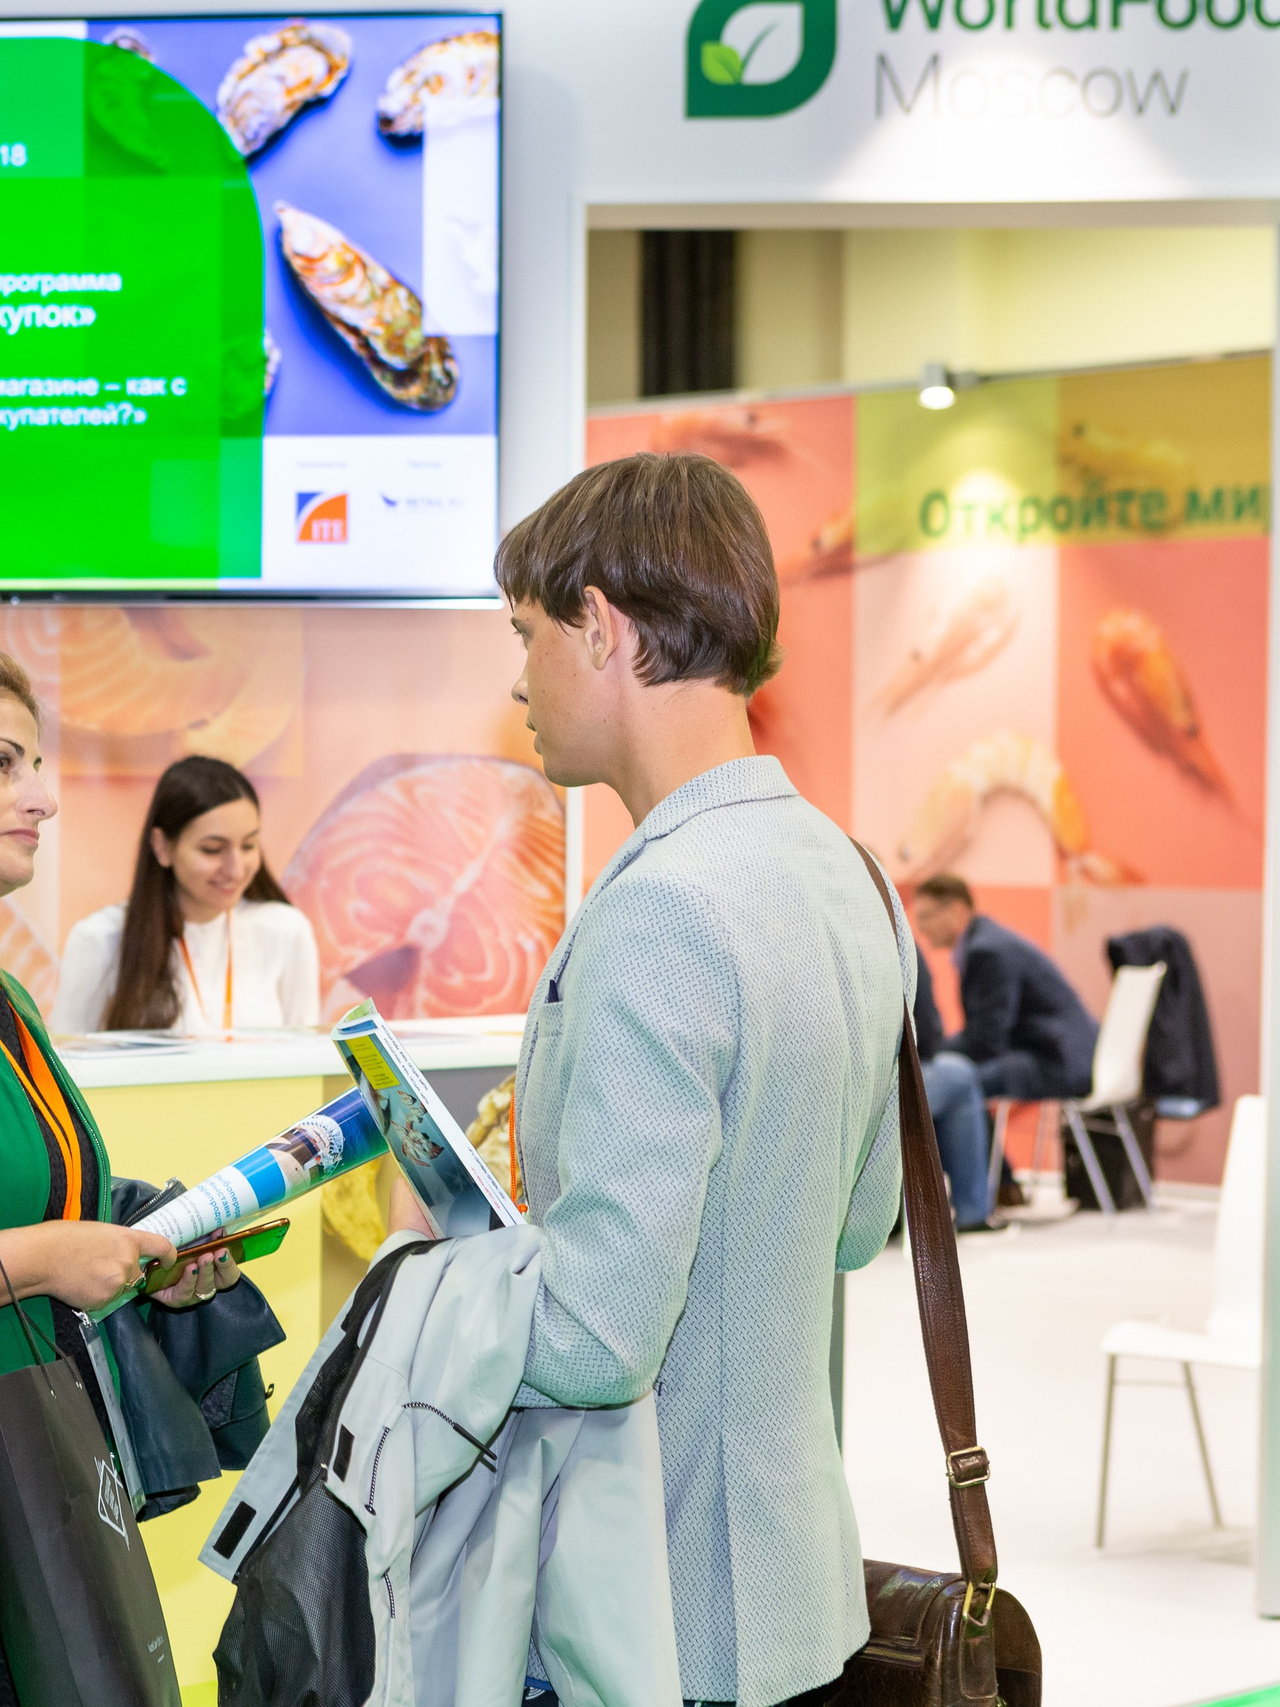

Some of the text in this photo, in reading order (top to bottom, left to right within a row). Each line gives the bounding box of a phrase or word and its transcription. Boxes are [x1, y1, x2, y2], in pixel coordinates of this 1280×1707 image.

[874, 50, 1190, 119] Moscow
[126, 376, 167, 396] как
[171, 378, 188, 396] с
[920, 474, 1167, 543] Откройте
